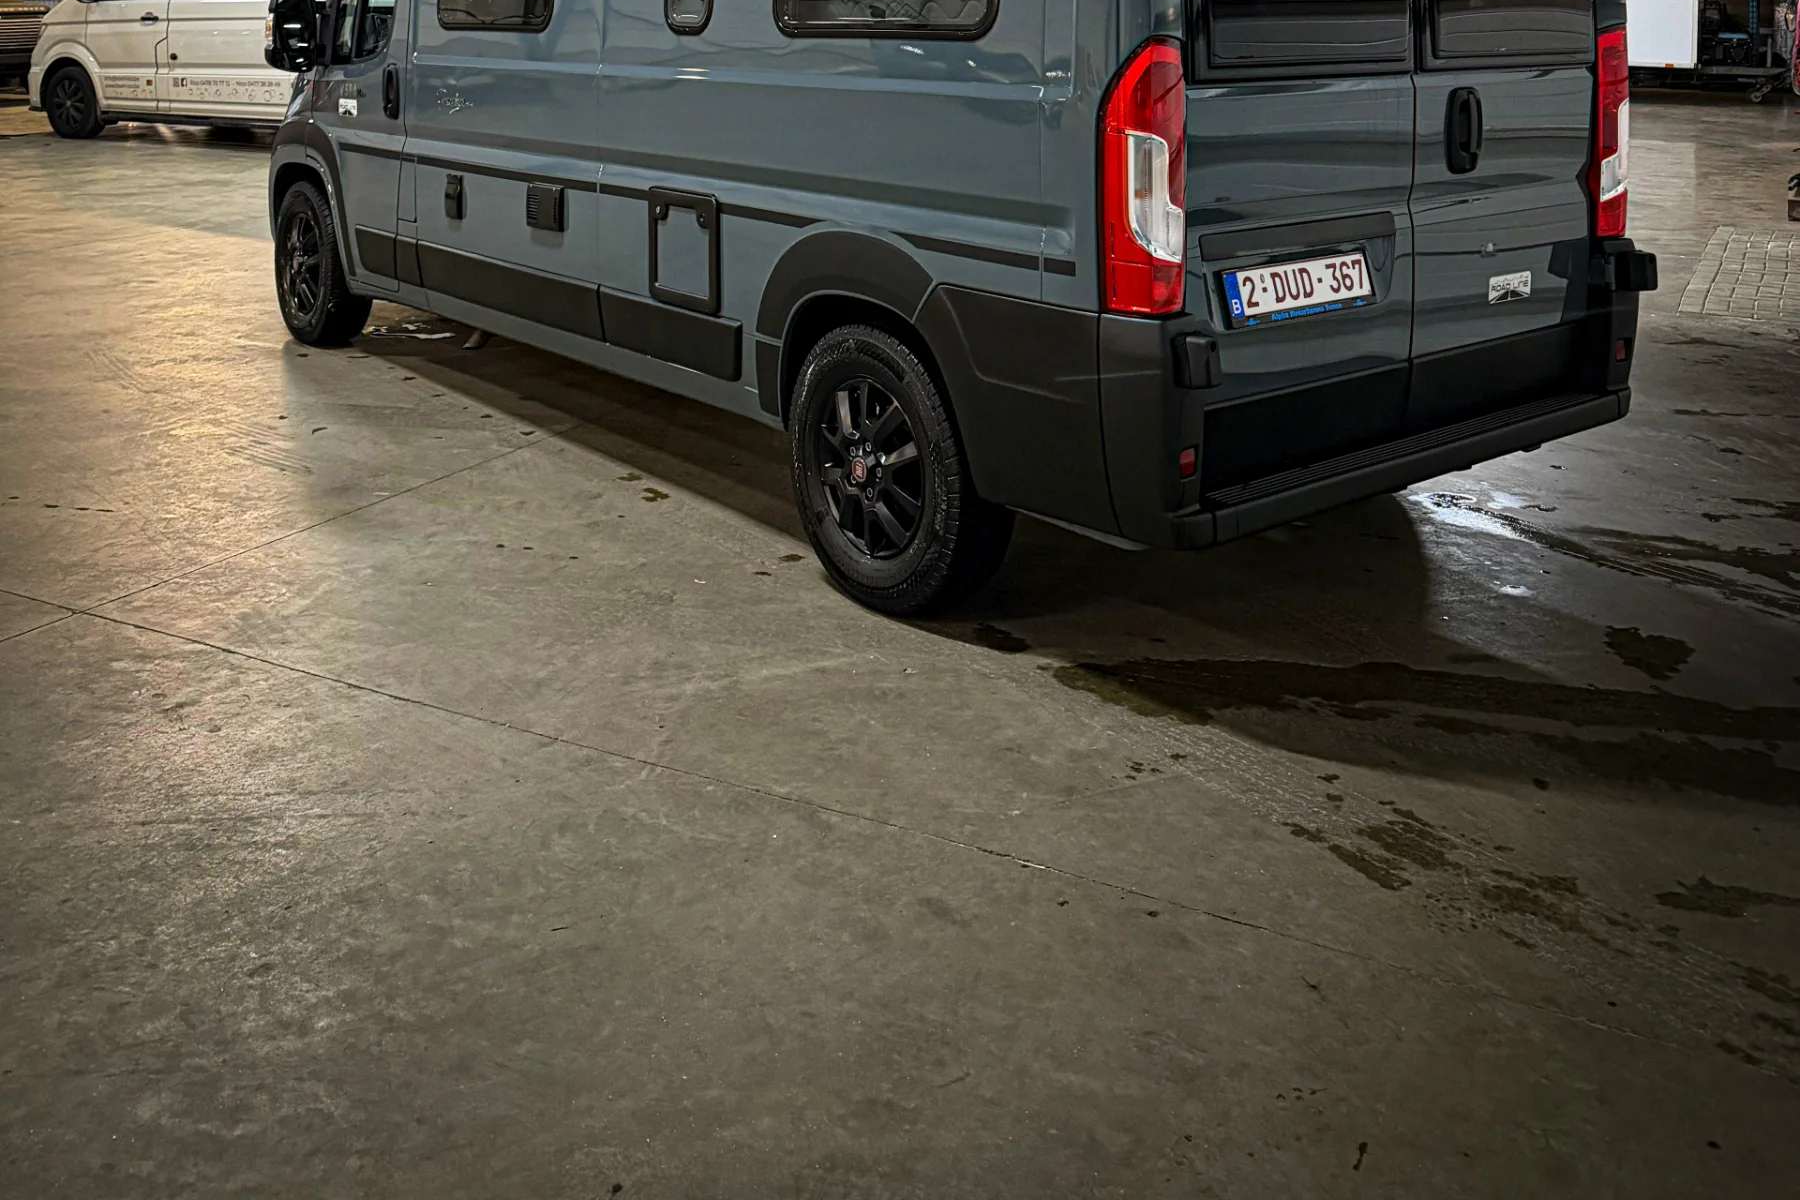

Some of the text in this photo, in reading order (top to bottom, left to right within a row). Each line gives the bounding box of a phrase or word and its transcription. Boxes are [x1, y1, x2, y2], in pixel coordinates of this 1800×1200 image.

[1242, 259, 1363, 308] 2-DUD-367
[1491, 282, 1511, 292] ROAD
[1231, 299, 1242, 314] B
